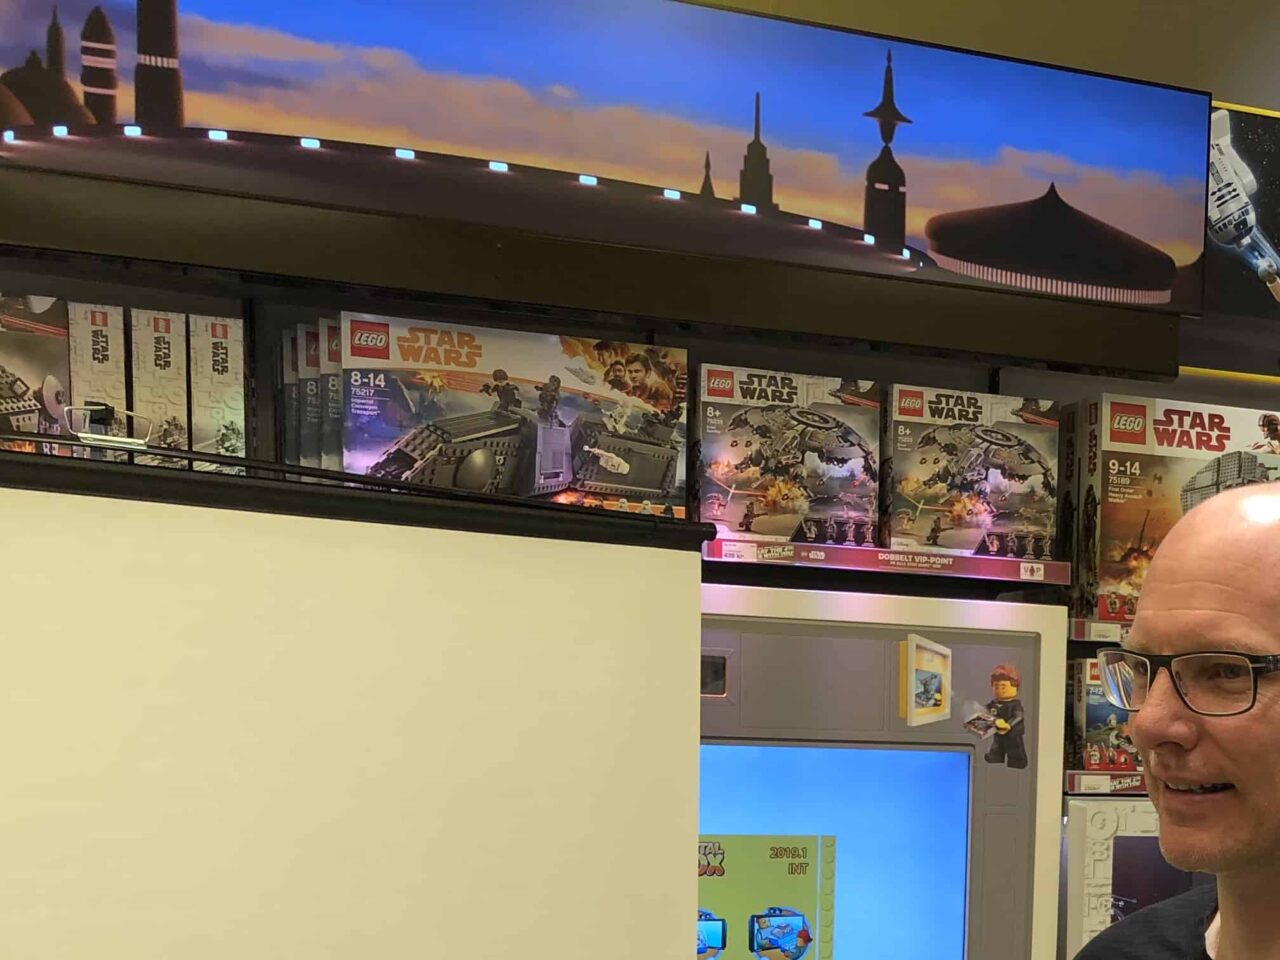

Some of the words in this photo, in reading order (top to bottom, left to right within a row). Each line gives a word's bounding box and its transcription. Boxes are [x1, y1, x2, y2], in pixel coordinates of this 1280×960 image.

[352, 331, 388, 348] LEGO
[397, 327, 482, 350] STAR
[397, 344, 482, 369] WARS
[351, 371, 386, 388] 8-14
[709, 378, 732, 390] LEGO
[739, 373, 798, 390] STAR
[351, 388, 375, 397] 75217
[739, 386, 798, 404] WARS
[900, 398, 922, 410] LEGO
[928, 393, 983, 410] STAR
[707, 406, 720, 417] 8+
[928, 406, 983, 423] WARS
[1112, 411, 1144, 433] LEGO
[1153, 408, 1231, 433] STAR
[898, 425, 911, 435] 8+
[1153, 426, 1231, 452] WARS
[1108, 459, 1141, 476] 9-14
[878, 553, 913, 562] DOBBELT
[915, 555, 954, 566] VIP-POINT
[769, 846, 808, 859] 2019.1
[788, 863, 809, 875] INT
